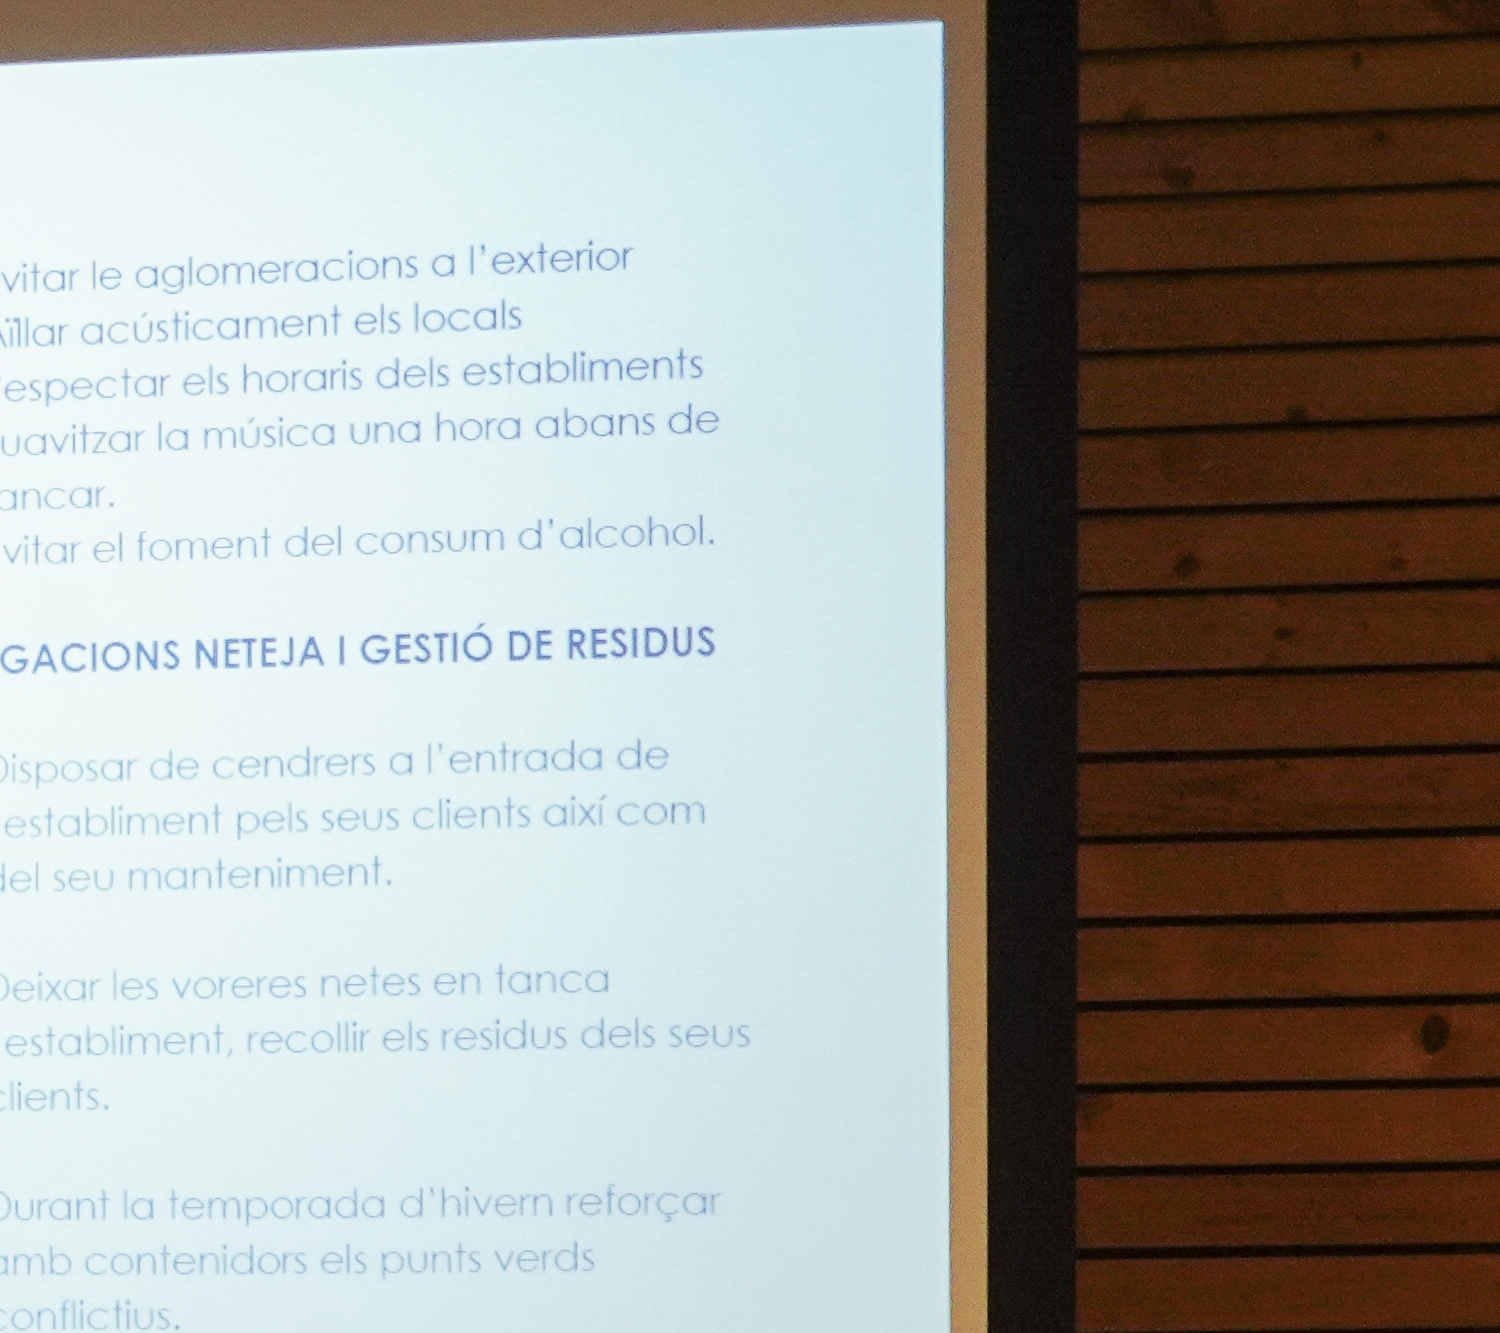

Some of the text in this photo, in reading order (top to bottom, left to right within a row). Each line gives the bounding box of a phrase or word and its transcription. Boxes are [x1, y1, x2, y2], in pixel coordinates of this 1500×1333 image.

[91, 260, 125, 293] le
[134, 248, 421, 298] aglomeracions
[430, 253, 458, 280] a
[469, 239, 635, 277] l'exterior
[79, 304, 343, 348] acústicament
[353, 303, 404, 338] els
[413, 299, 525, 336] locals
[181, 364, 232, 399] els
[241, 358, 365, 396] horaris
[375, 356, 452, 392] dels
[461, 348, 706, 389] establiments
[157, 421, 192, 454] la
[202, 416, 338, 452] música
[349, 420, 424, 448] una
[434, 411, 524, 444] hora
[534, 407, 658, 441] abans
[667, 402, 722, 437] de
[92, 532, 126, 565] el
[137, 528, 273, 564] foment
[284, 524, 345, 560] del
[355, 528, 508, 558] consum
[517, 513, 717, 553] d'alcohol.
[194, 635, 327, 671] NETEJA
[338, 634, 347, 667] I
[359, 622, 495, 668] GESTIÓ
[507, 629, 554, 664] DE
[567, 625, 718, 662] RESIDUS
[149, 749, 202, 783] de
[212, 746, 379, 782] cendrers
[389, 751, 417, 778] a
[427, 739, 606, 776] l'entrada
[616, 738, 672, 773] de
[236, 802, 312, 843] pels
[321, 807, 403, 835] seus
[412, 797, 534, 833] clients
[542, 794, 609, 830] així
[616, 800, 709, 829] com
[53, 869, 117, 895] seu
[128, 854, 395, 893] manteniment.
[111, 969, 161, 1003] les
[171, 974, 309, 1002] voreres
[319, 965, 423, 1001] netes
[432, 971, 483, 999] en
[495, 963, 612, 997] tanca
[246, 1020, 372, 1057] recollir
[381, 1020, 431, 1055] els
[440, 1018, 570, 1054] residus
[579, 1016, 658, 1052] dels
[668, 1023, 753, 1051] seus
[122, 1190, 157, 1223] la
[168, 1187, 388, 1229] temporada
[399, 1185, 556, 1221] d'hivern
[565, 1183, 723, 1226] reforçar
[84, 1243, 310, 1279] contenidors
[319, 1243, 370, 1277] els
[380, 1242, 484, 1283] punts
[494, 1240, 598, 1276] verds
